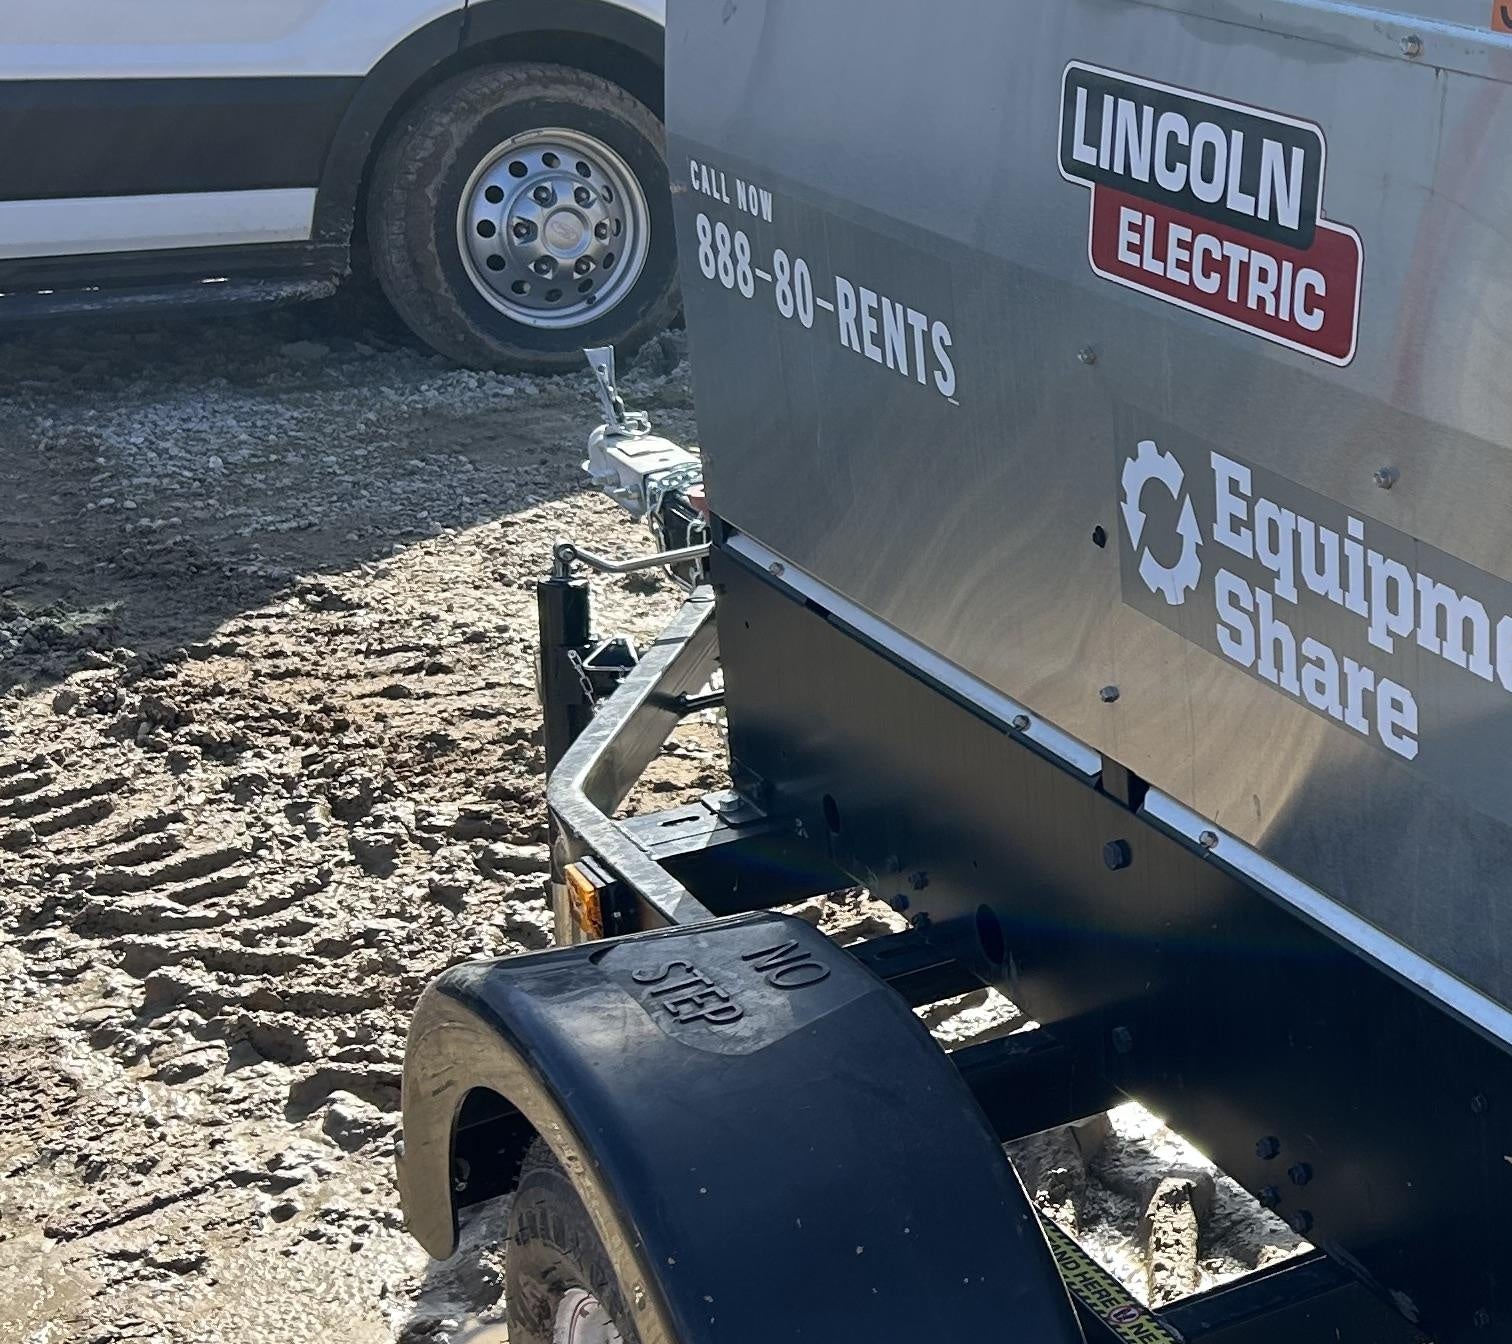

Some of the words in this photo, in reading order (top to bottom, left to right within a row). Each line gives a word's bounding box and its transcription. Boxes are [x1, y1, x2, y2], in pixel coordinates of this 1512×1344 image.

[690, 160, 730, 204] CALL
[736, 178, 773, 222] NOW
[1073, 87, 1304, 230] LINCOLN
[1118, 206, 1326, 332] ELECTRIC
[696, 213, 956, 397] 888-80-RENTS
[1215, 568, 1418, 760] Share
[632, 960, 744, 1025] STEP
[742, 940, 831, 990] NO
[1074, 1270, 1119, 1308] HERE
[1128, 1323, 1159, 1344] NE
